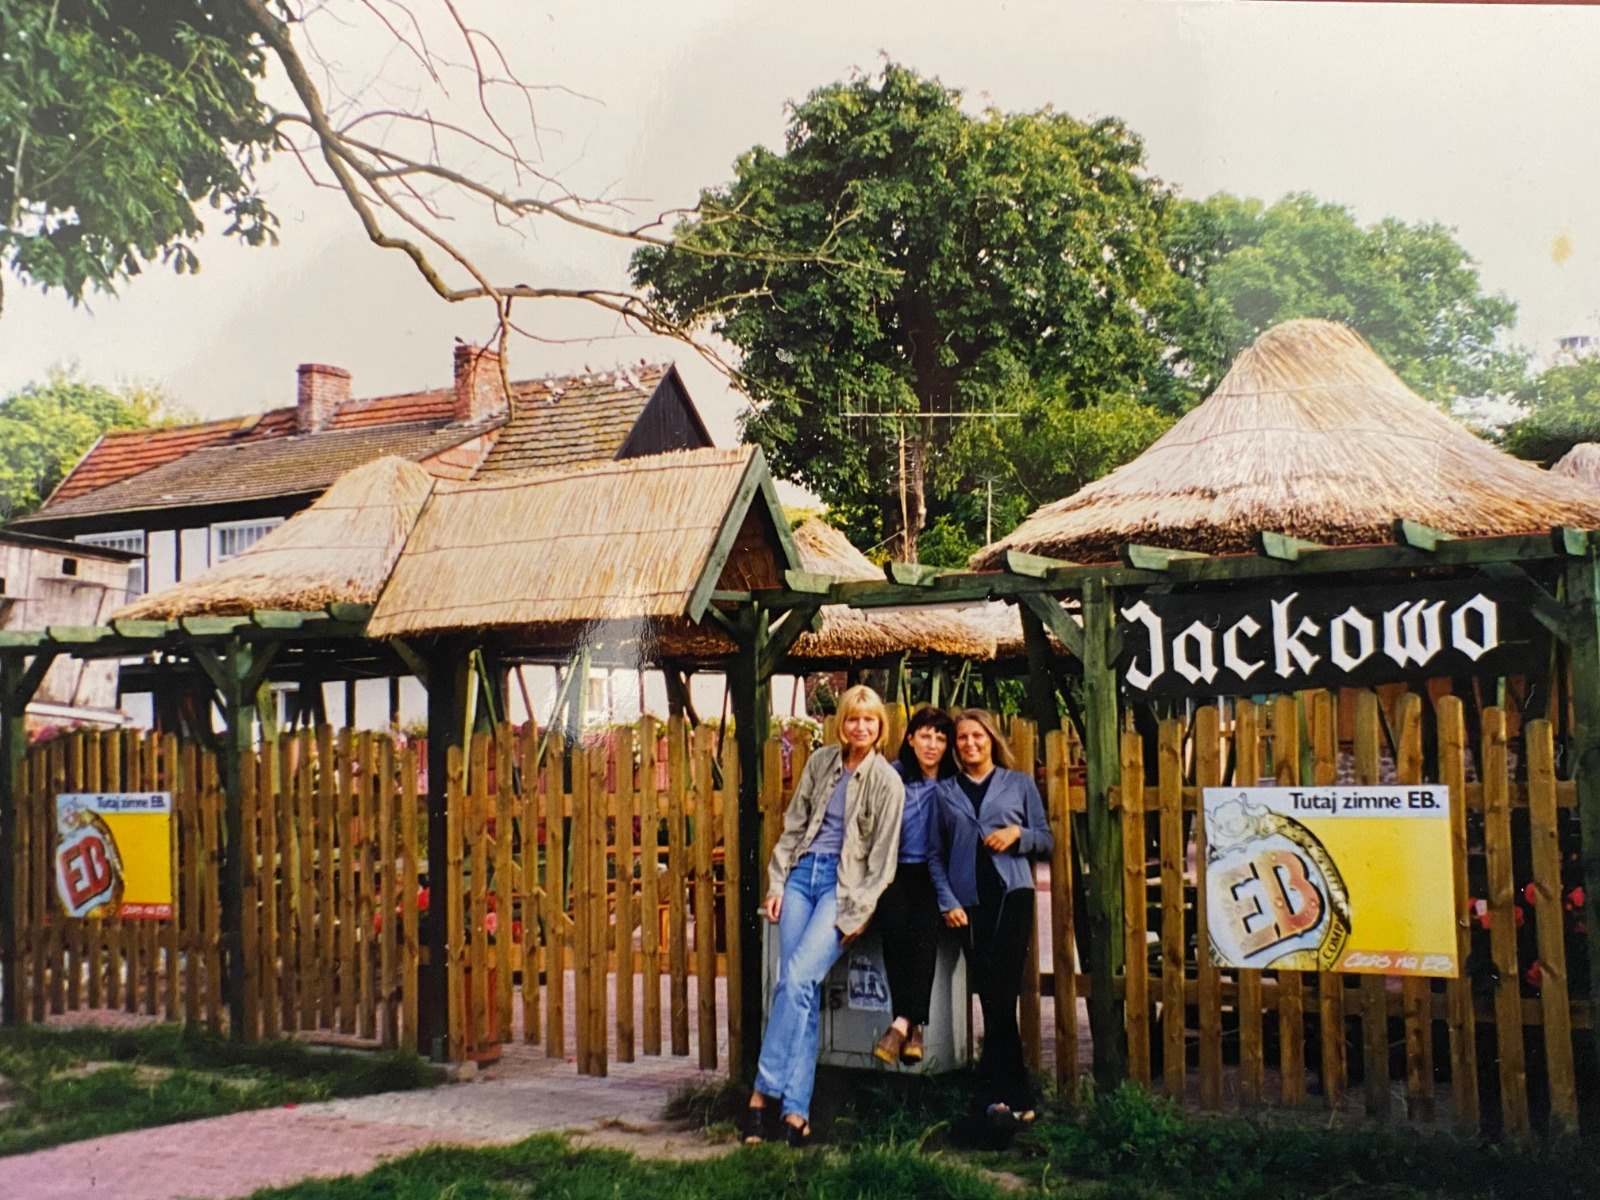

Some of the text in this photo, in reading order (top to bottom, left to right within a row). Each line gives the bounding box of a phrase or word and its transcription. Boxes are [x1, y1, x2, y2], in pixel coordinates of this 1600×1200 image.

[1120, 591, 1499, 692] Jackowo
[1289, 790, 1441, 814] Tutaj zimne EB.
[60, 835, 112, 910] EB
[1217, 850, 1326, 960] EB
